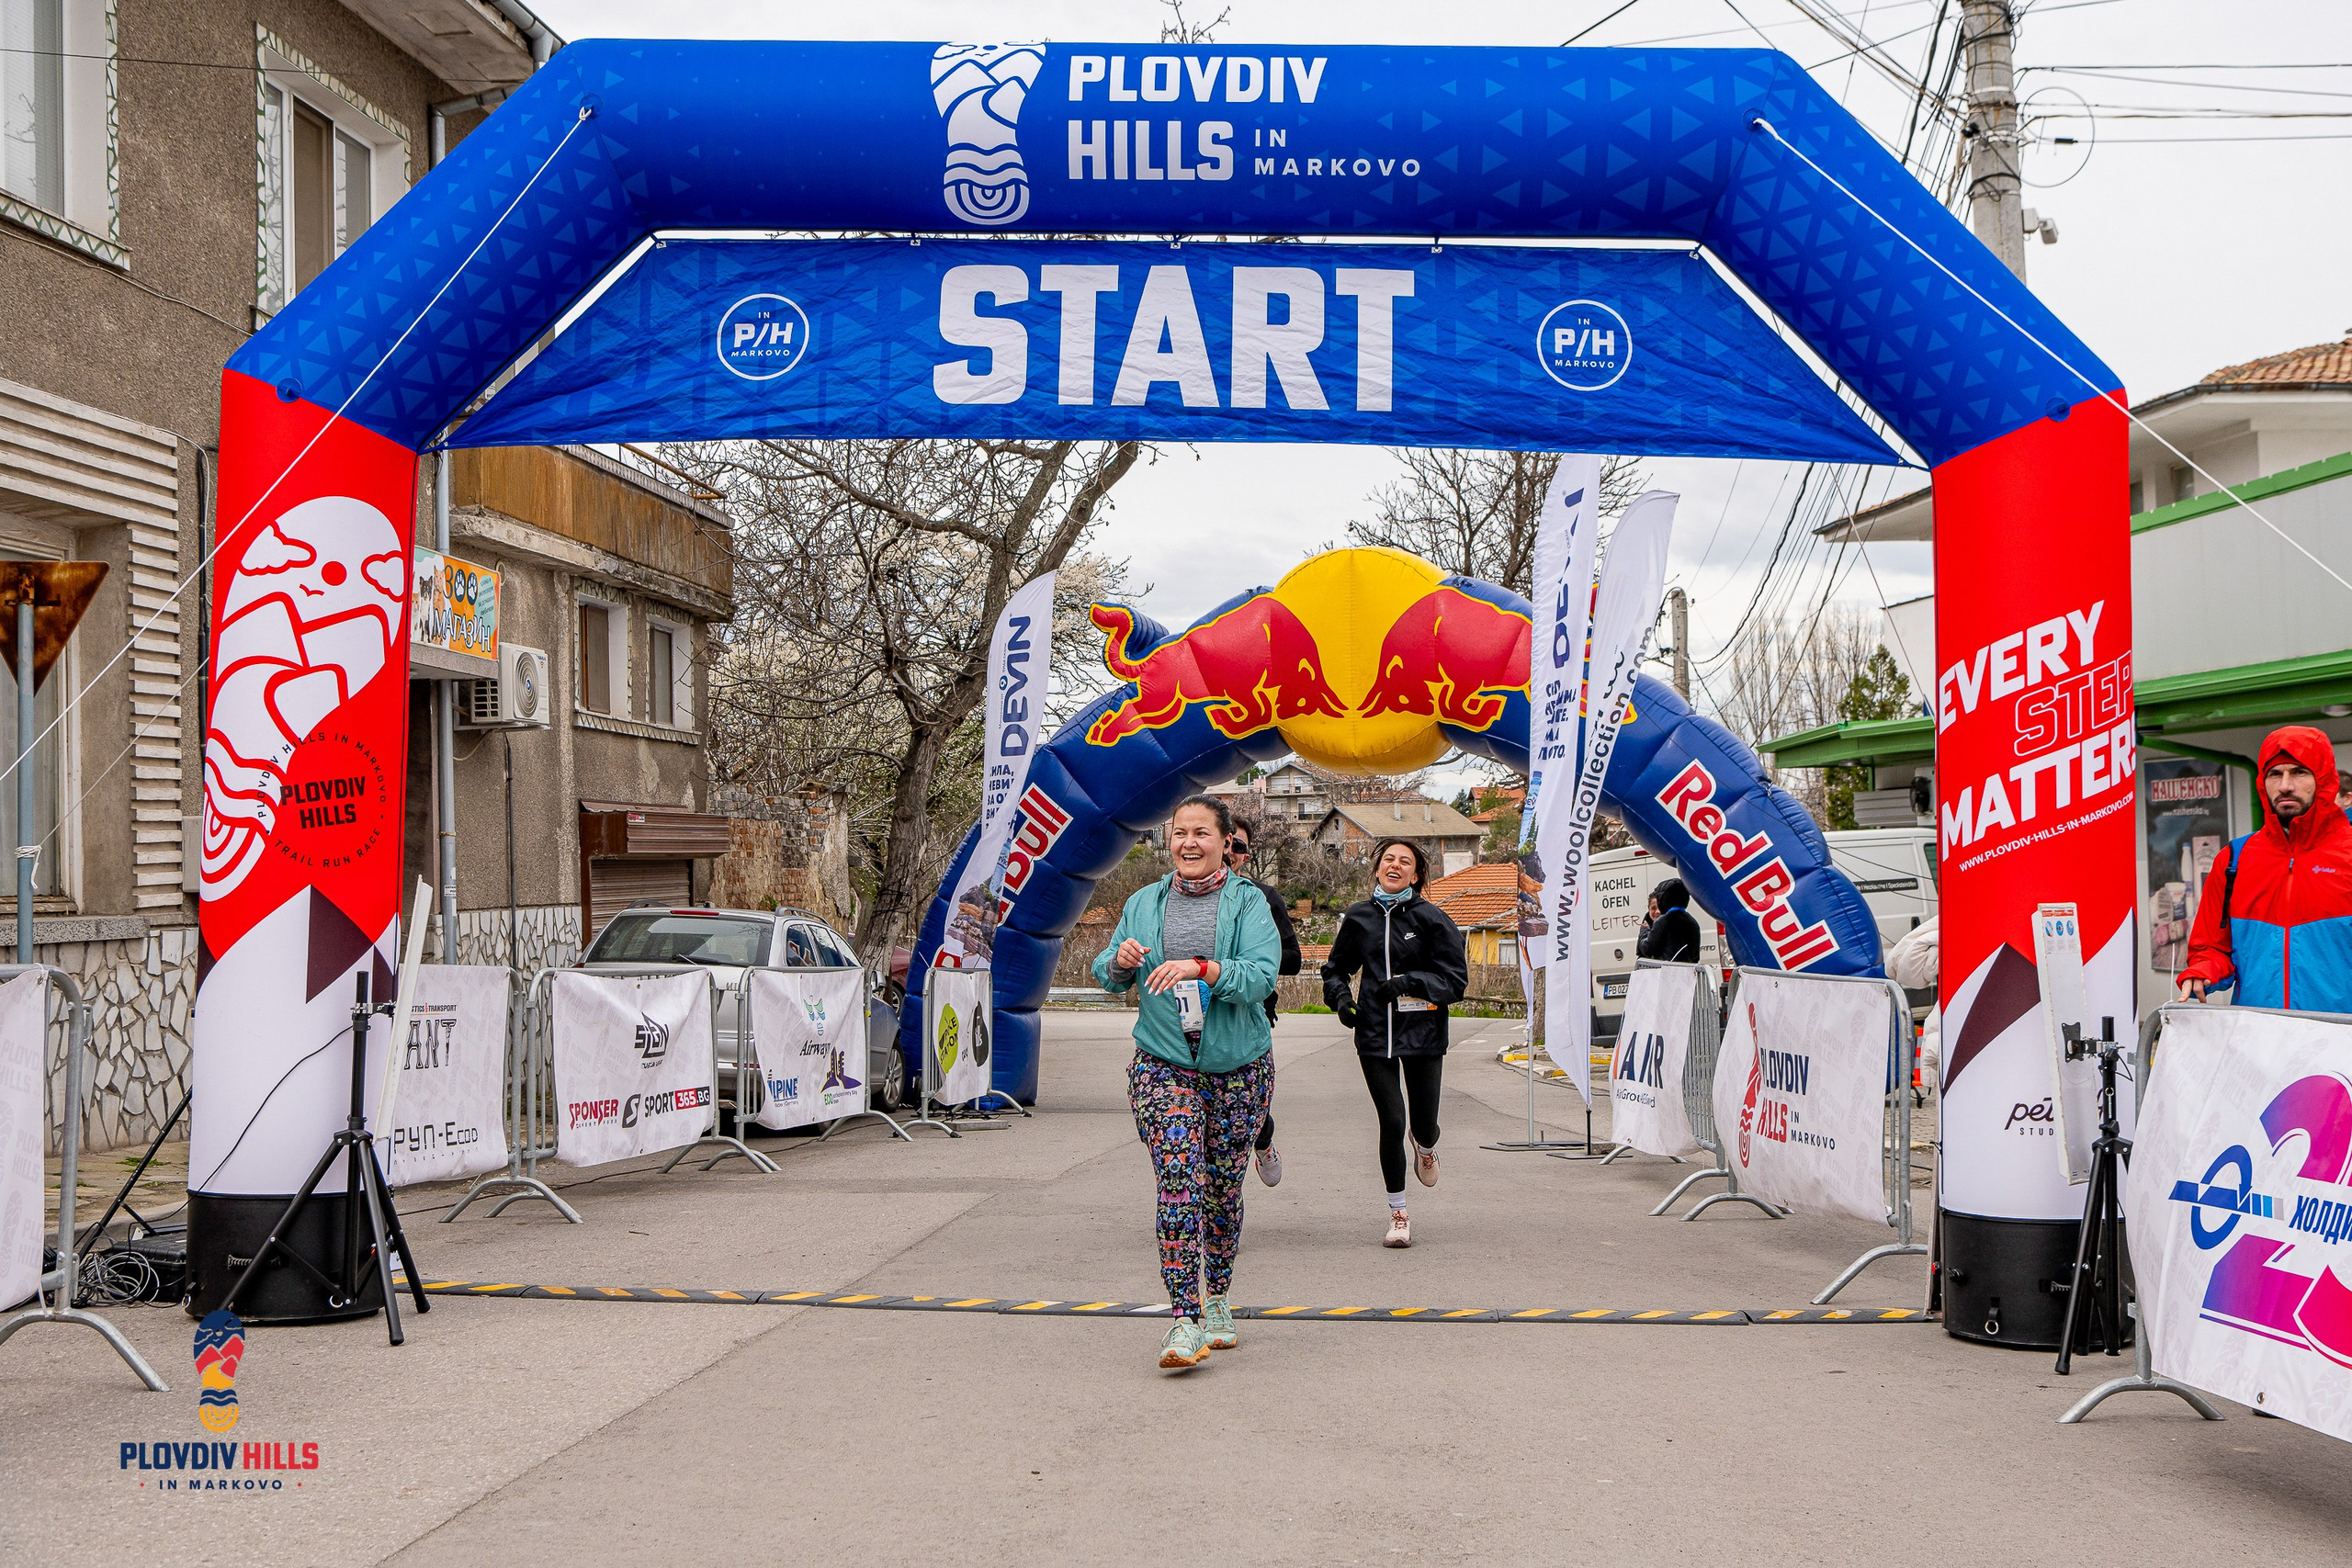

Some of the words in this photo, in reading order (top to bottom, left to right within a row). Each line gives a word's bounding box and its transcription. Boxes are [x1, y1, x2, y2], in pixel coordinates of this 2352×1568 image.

[1069, 55, 1328, 103] PLOVDIV
[1069, 119, 1234, 181] HILLS
[1255, 129, 1286, 147] IN
[1254, 158, 1421, 176] MARKOVO
[733, 321, 794, 348] P/H
[933, 264, 1415, 412] START
[1554, 328, 1615, 357] P/H
[730, 349, 790, 357] MARKOVO
[1555, 359, 1615, 368] MARKOVO
[433, 608, 492, 653] МАГАЗИН
[1939, 600, 2105, 735] EVERY
[1000, 615, 1031, 757] DEVIN
[2014, 650, 2132, 756] STEP
[257, 756, 279, 818] PLOVDIV
[282, 732, 325, 754] HILLS
[334, 733, 349, 744] IN
[355, 741, 386, 803] MARKOVO
[2151, 776, 2220, 802] НАШЕНСКО
[279, 776, 366, 806] PLOVDIV
[300, 804, 356, 829] HILLS
[276, 840, 313, 866] TRAIL
[322, 855, 351, 868] RUN
[356, 828, 381, 858] RACE
[1657, 761, 1770, 877] Red
[1734, 858, 1838, 972] Bull
[1594, 876, 1636, 893] KACHEL
[1601, 895, 1630, 908] ÖFEN
[1592, 915, 1645, 931] LEITER
[428, 1004, 457, 1012] TRANSPORT
[569, 1099, 619, 1131] SPONSER
[1791, 1110, 1800, 1123] IN
[1791, 1129, 1836, 1150] MARKOVO
